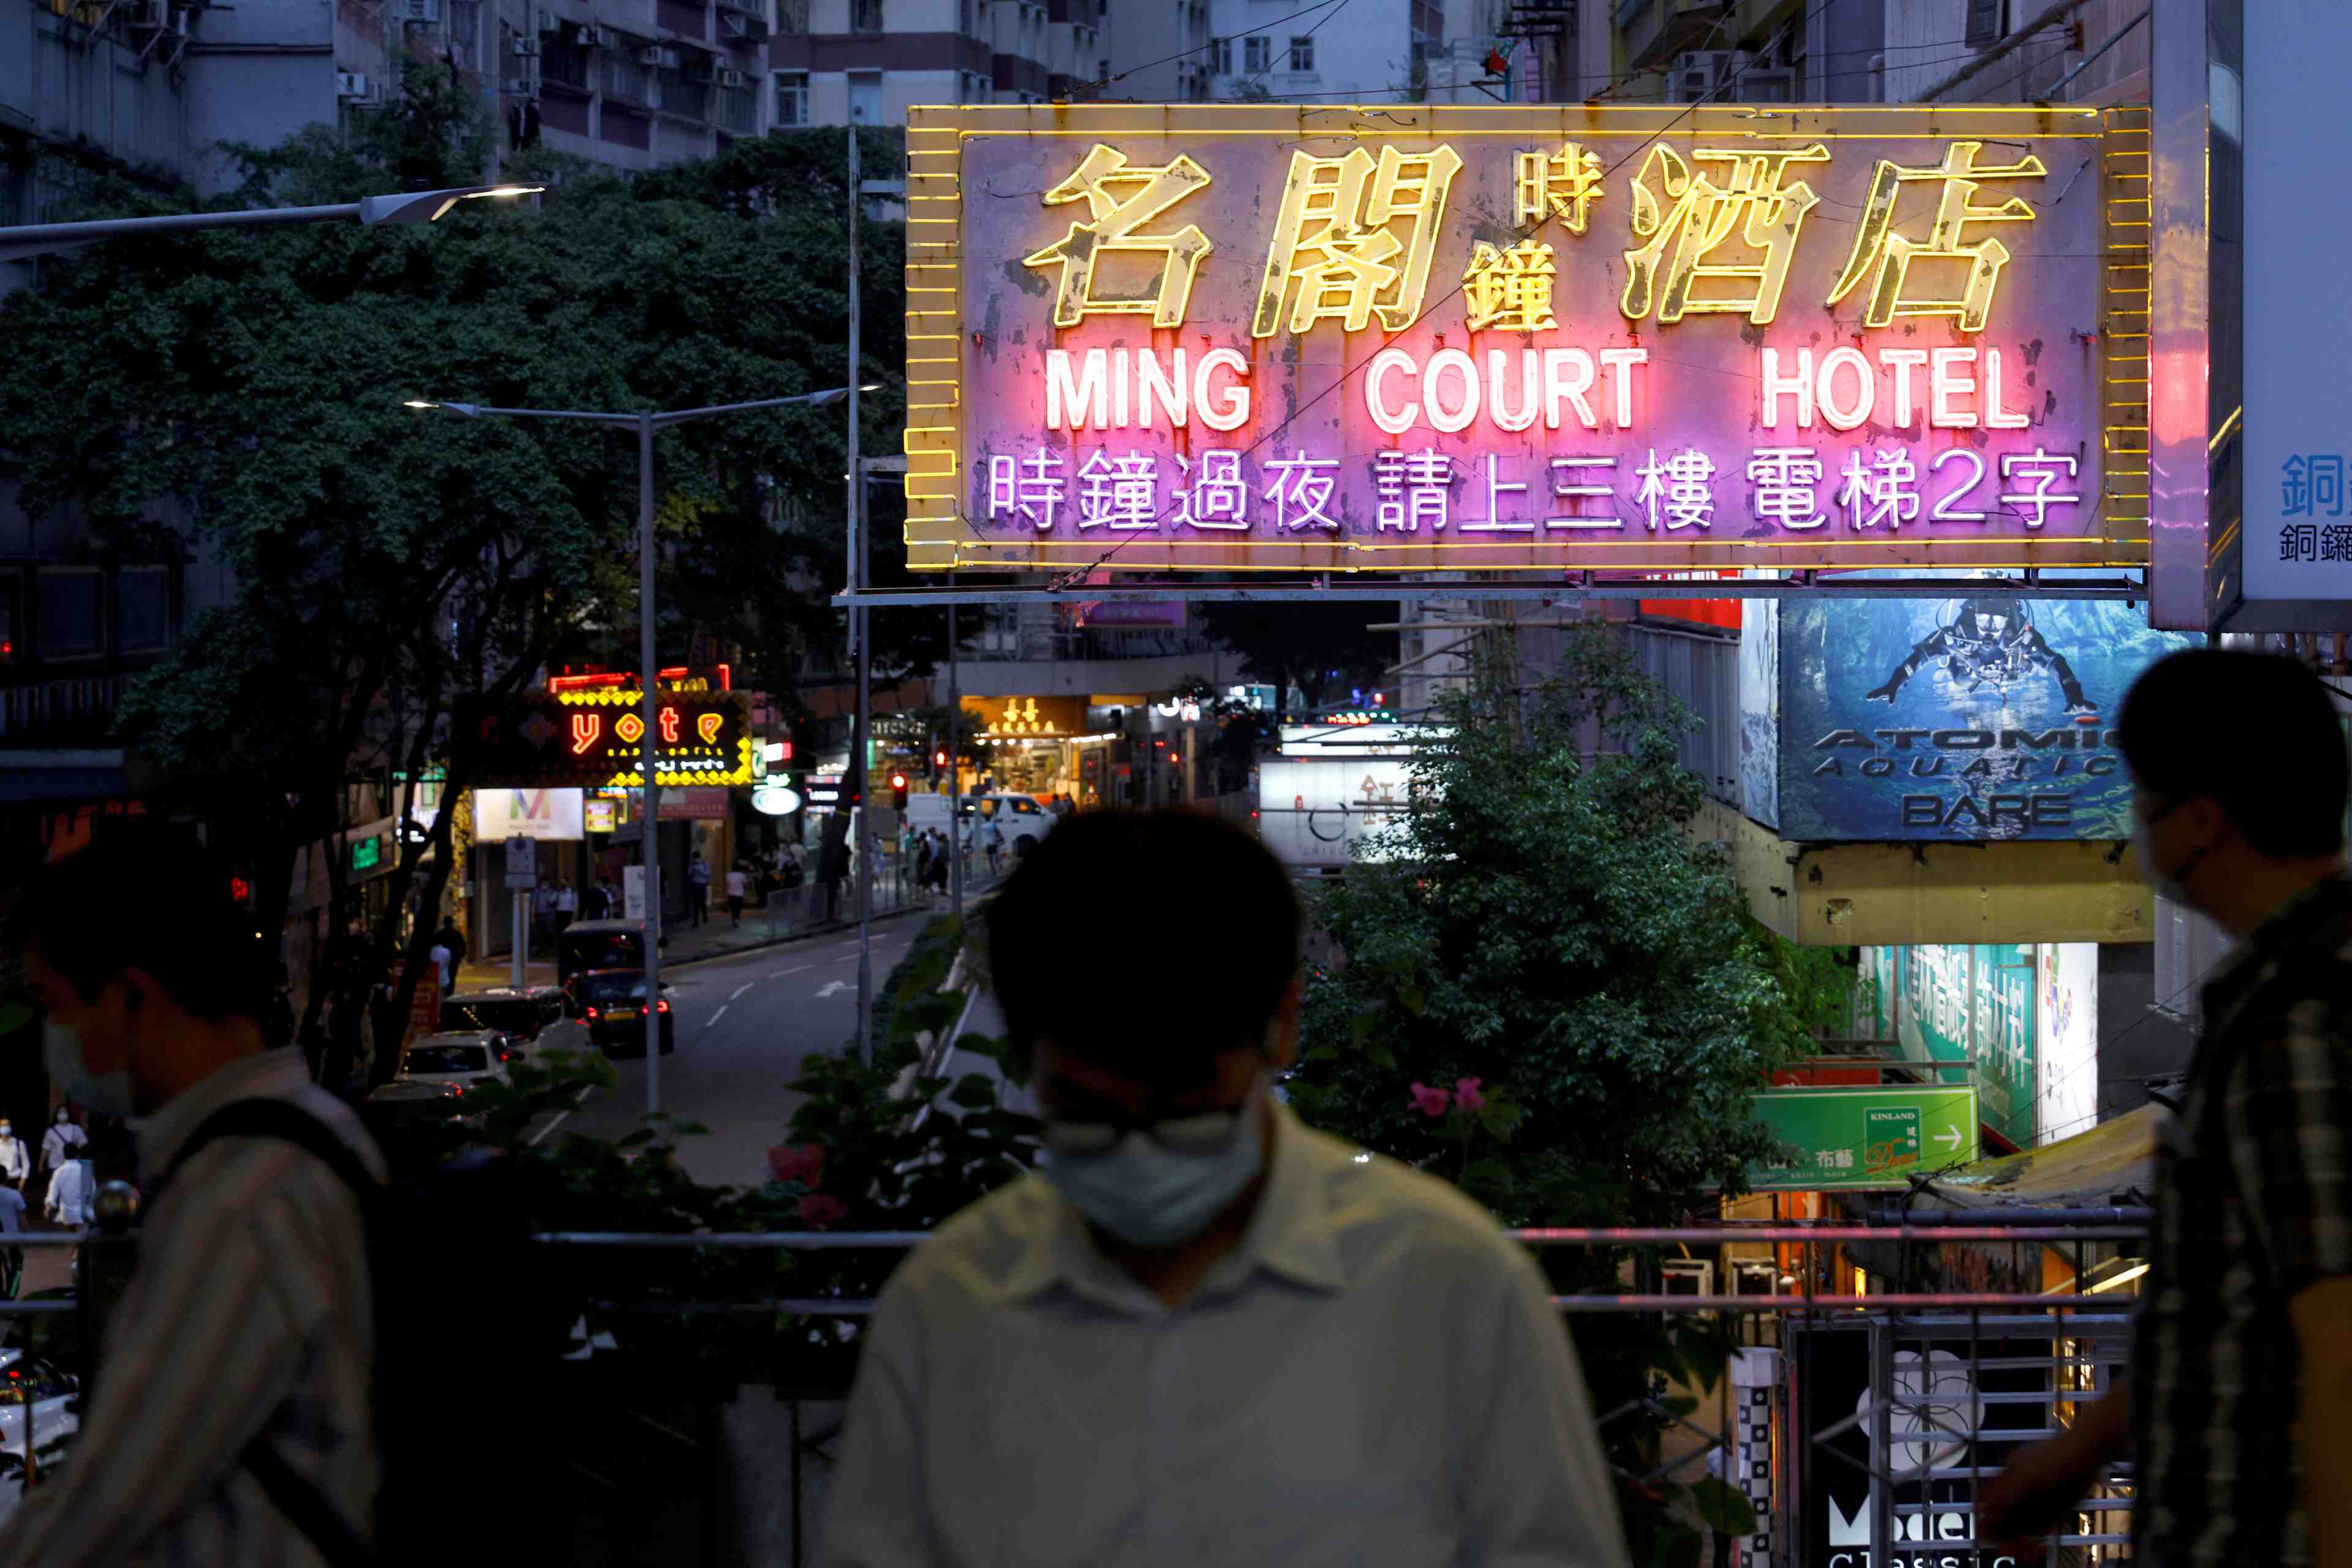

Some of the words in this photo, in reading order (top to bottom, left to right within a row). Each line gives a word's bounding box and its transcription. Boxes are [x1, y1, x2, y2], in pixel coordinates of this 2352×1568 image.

[1046, 347, 1251, 432] MING
[1363, 347, 1649, 434] COURT
[1762, 345, 2029, 431] HOTEL
[2281, 453, 2352, 516] 銅
[1901, 794, 2073, 827] BARE
[1871, 1112, 1915, 1121] KINLAND
